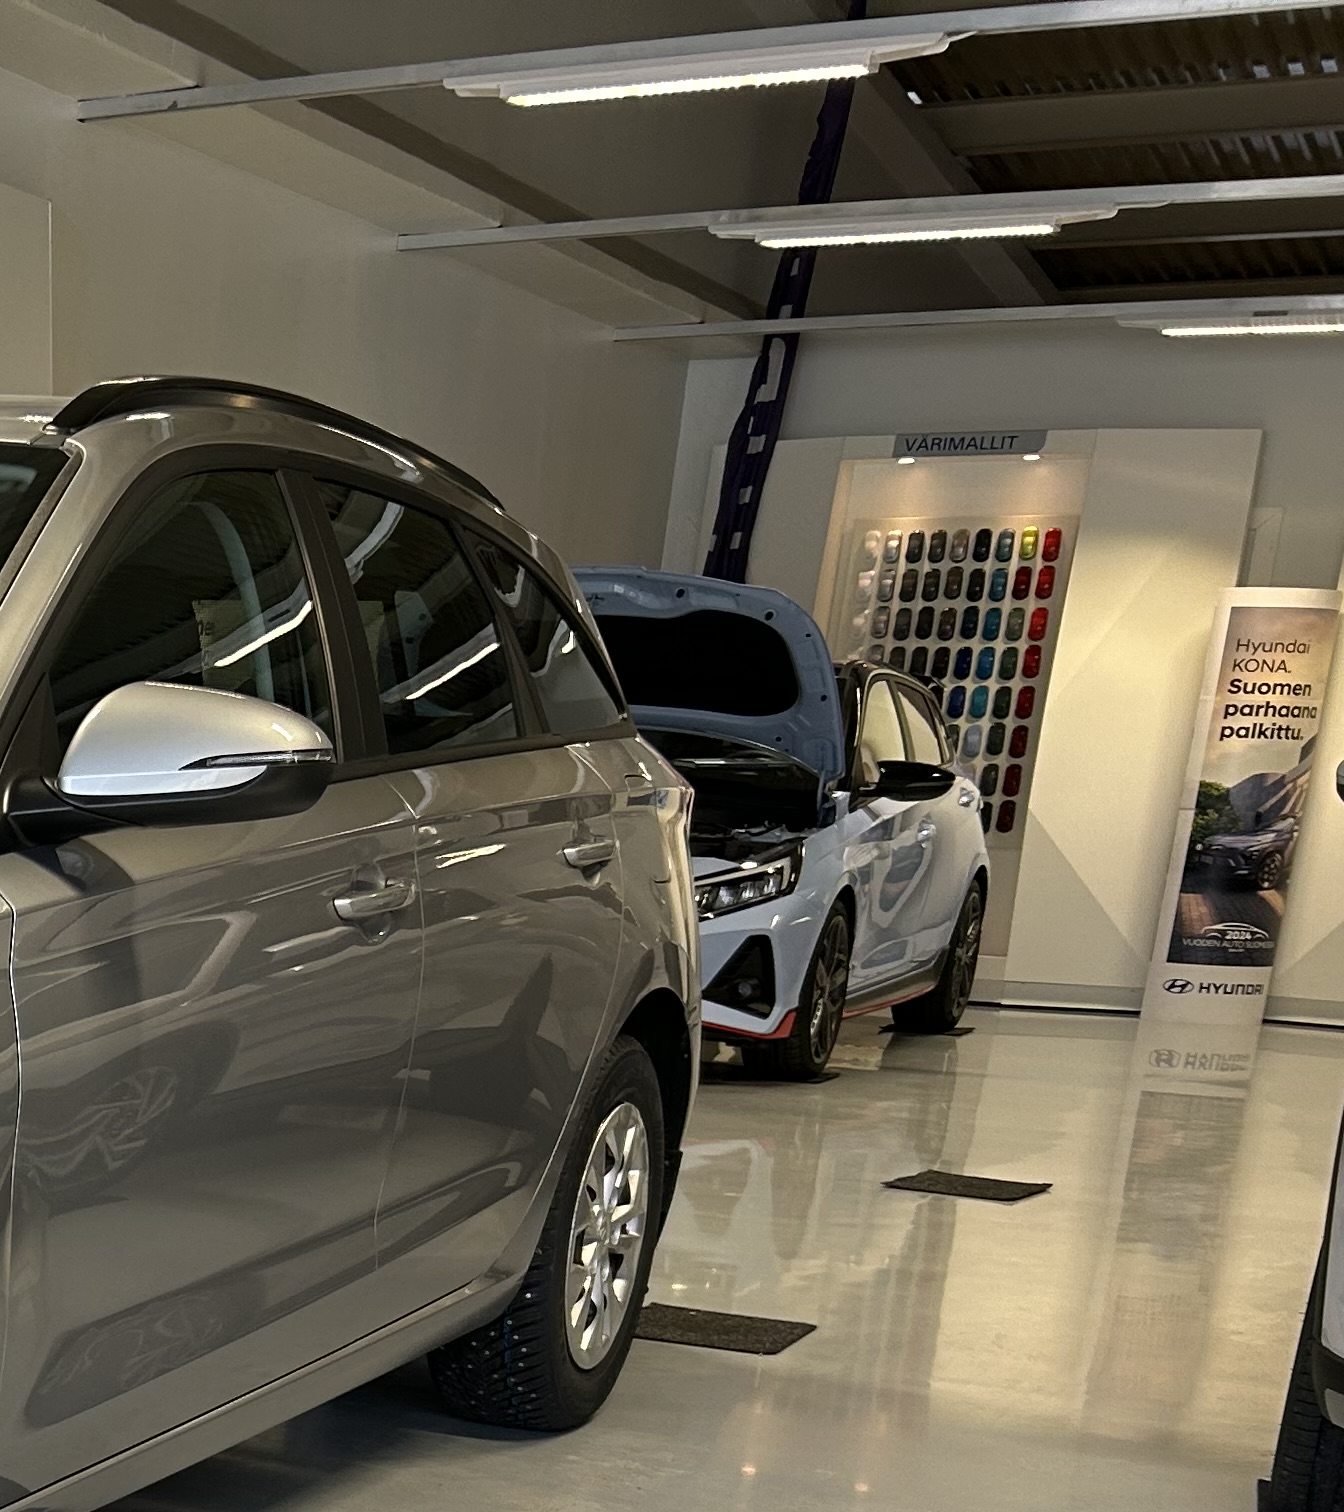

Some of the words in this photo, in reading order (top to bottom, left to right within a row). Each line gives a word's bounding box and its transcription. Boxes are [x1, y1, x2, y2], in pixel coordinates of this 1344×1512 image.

[905, 435, 1019, 452] VÄRIMALLIT
[1235, 638, 1312, 656] Hyundai
[1232, 658, 1292, 673] KONA.
[1227, 678, 1312, 697] Suomen
[1223, 701, 1318, 719] parhaana
[1219, 722, 1304, 741] palkittu.
[1224, 931, 1252, 940] 2024
[1199, 982, 1265, 995] HYUNDAI
